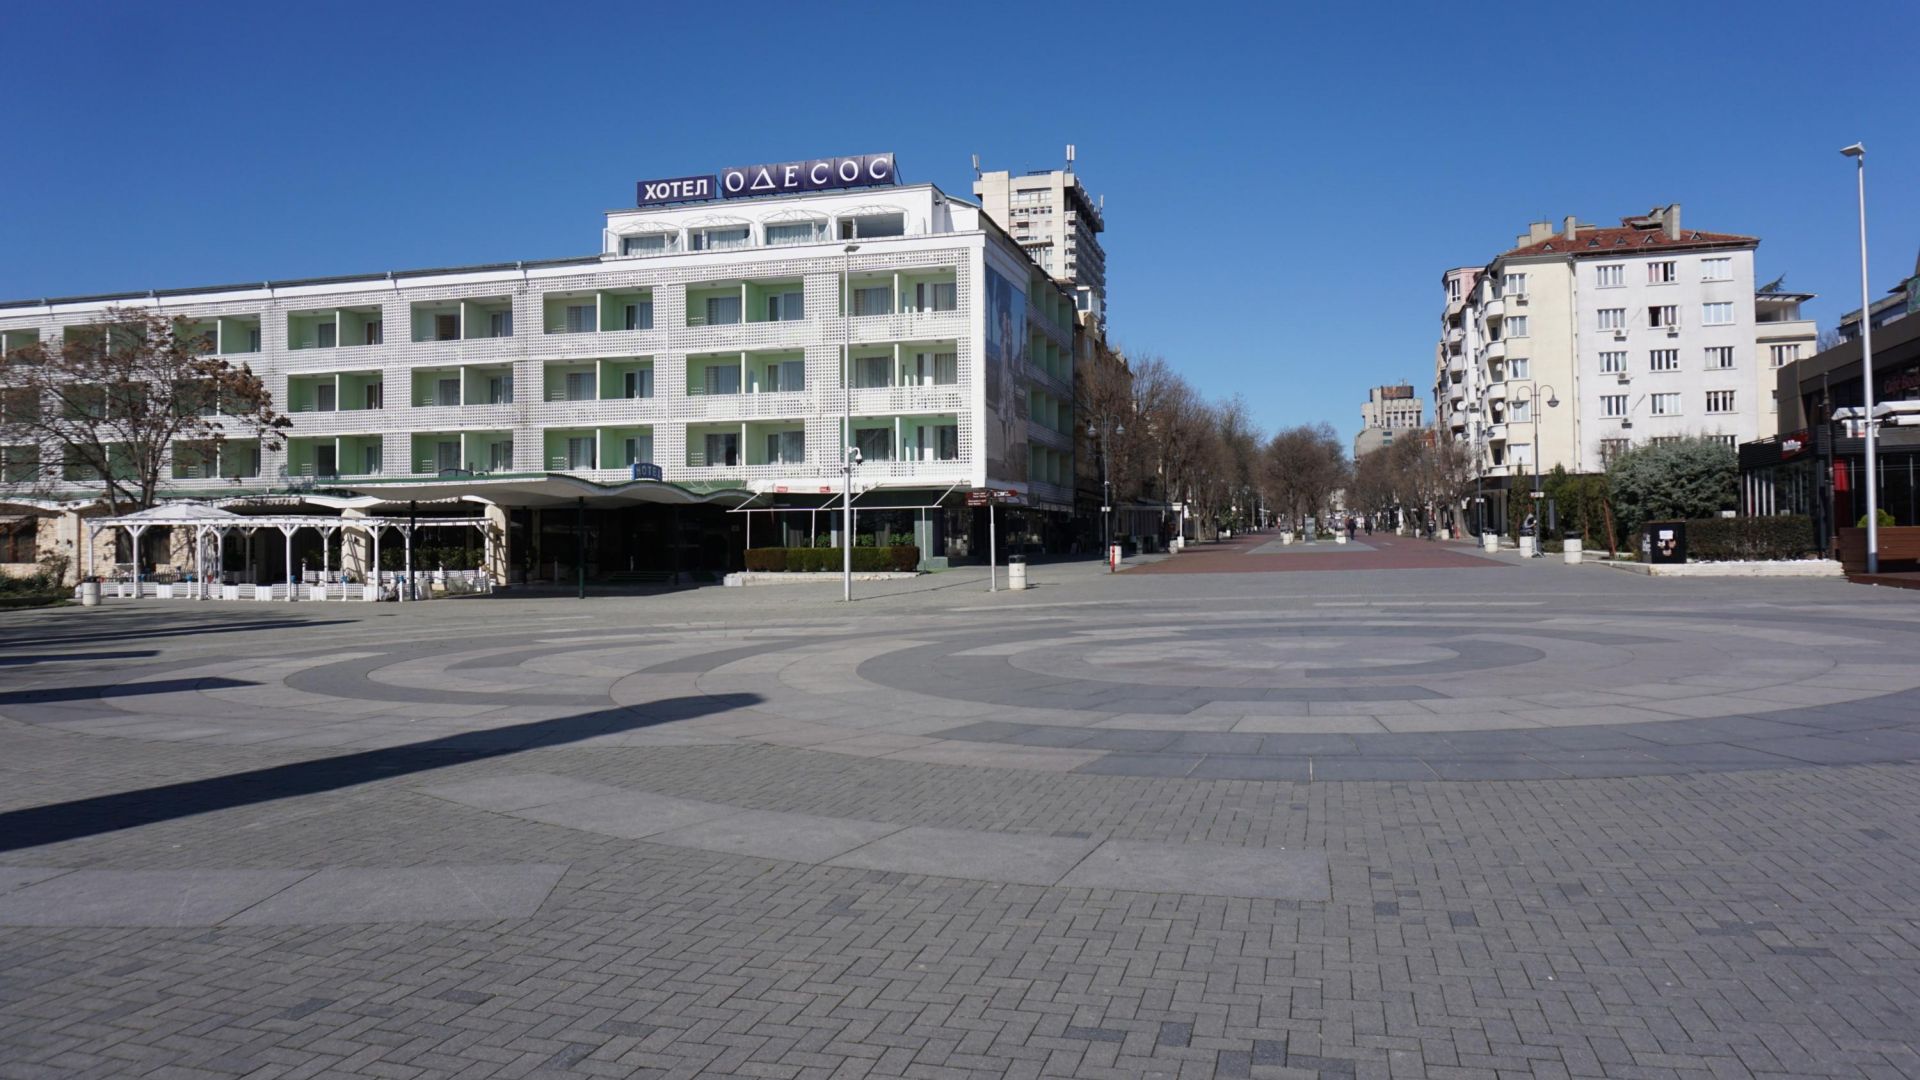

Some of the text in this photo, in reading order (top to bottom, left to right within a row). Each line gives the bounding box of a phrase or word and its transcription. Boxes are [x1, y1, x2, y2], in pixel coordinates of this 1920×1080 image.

[644, 157, 888, 200] ХОТЕЛ ОДЕСОС
[636, 464, 661, 478] HOTEL
